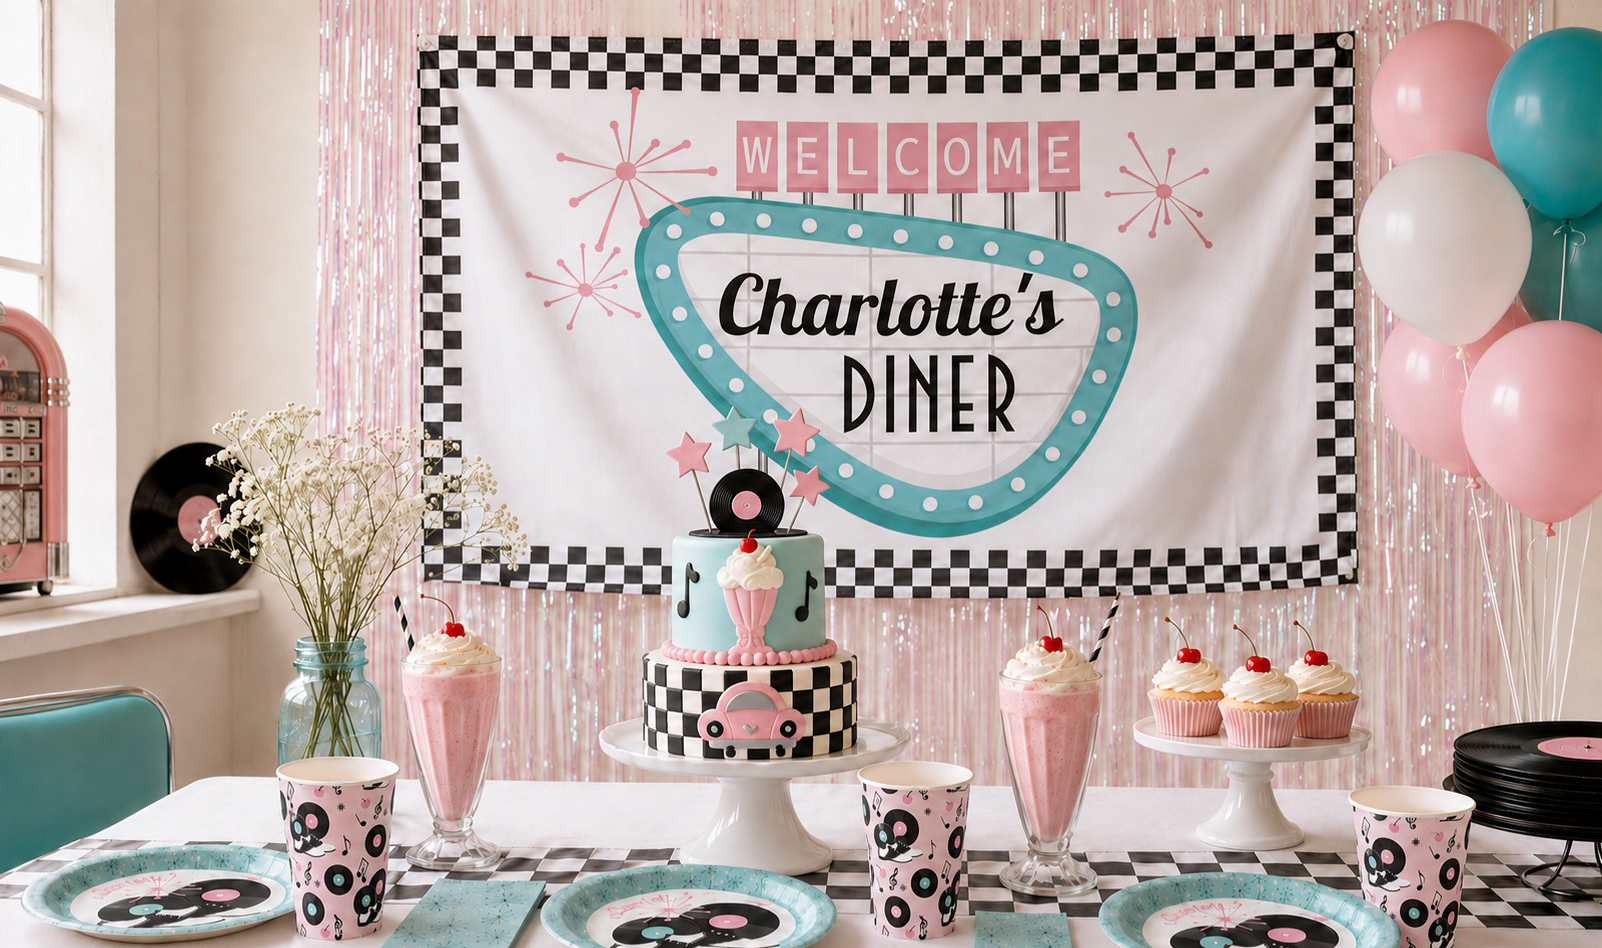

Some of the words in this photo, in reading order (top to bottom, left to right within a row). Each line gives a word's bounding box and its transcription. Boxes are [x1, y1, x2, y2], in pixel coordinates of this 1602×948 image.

[741, 135, 1071, 176] WELCOME
[718, 272, 1064, 337] Charlotte's
[843, 354, 1016, 434] DINER
